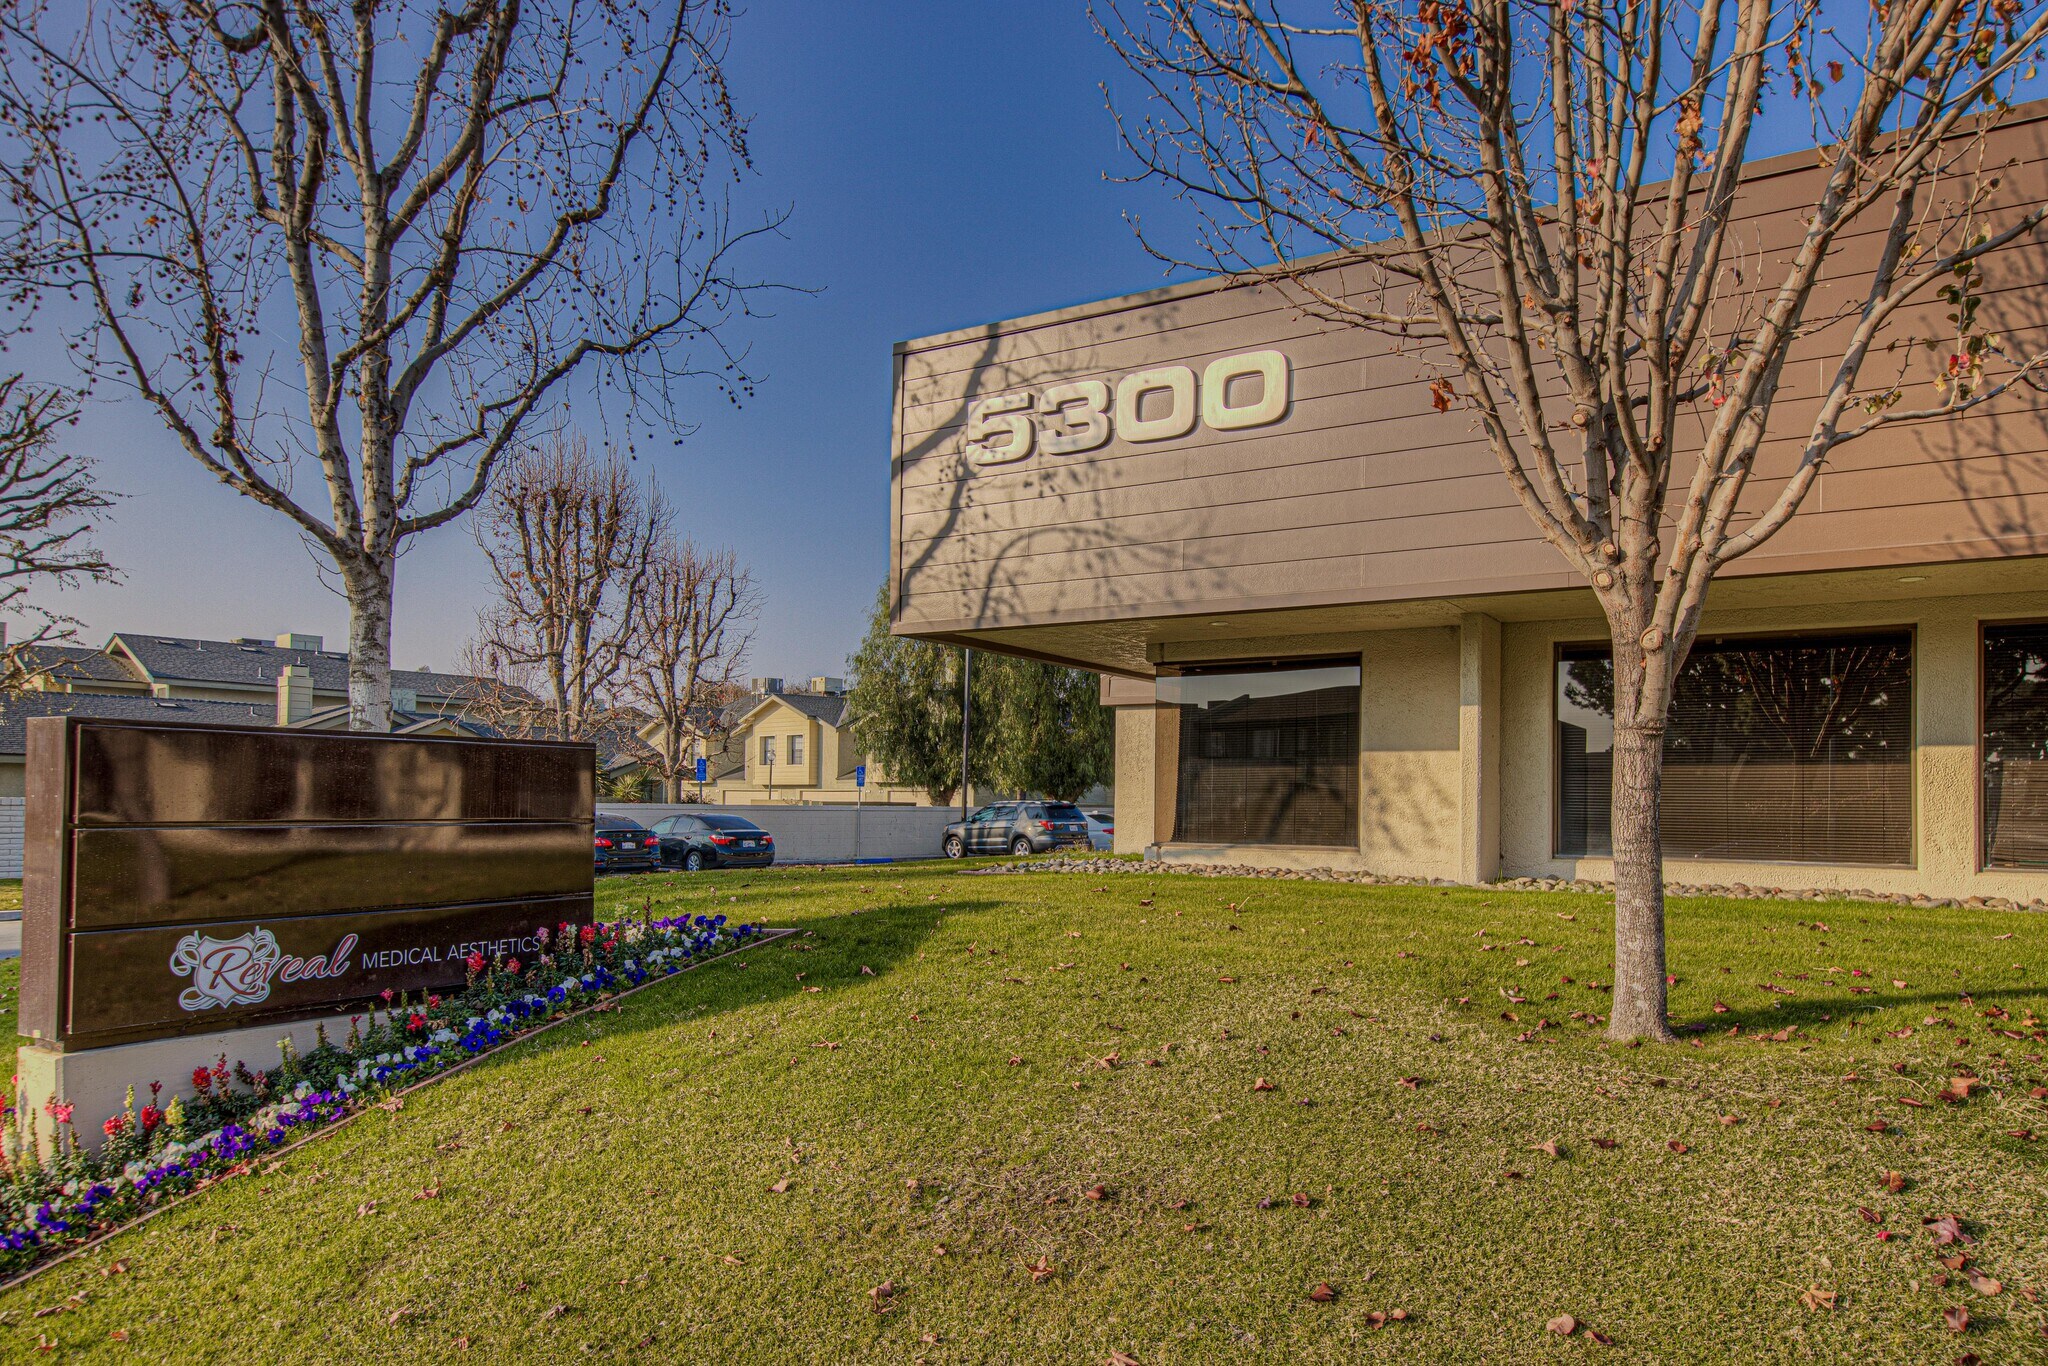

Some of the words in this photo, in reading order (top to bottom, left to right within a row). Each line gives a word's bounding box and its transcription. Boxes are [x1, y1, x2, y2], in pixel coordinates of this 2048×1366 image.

[966, 350, 1290, 465] 5300
[201, 933, 359, 996] Reveal
[362, 947, 442, 970] MEDICAL
[447, 936, 540, 961] AESTHETICS
